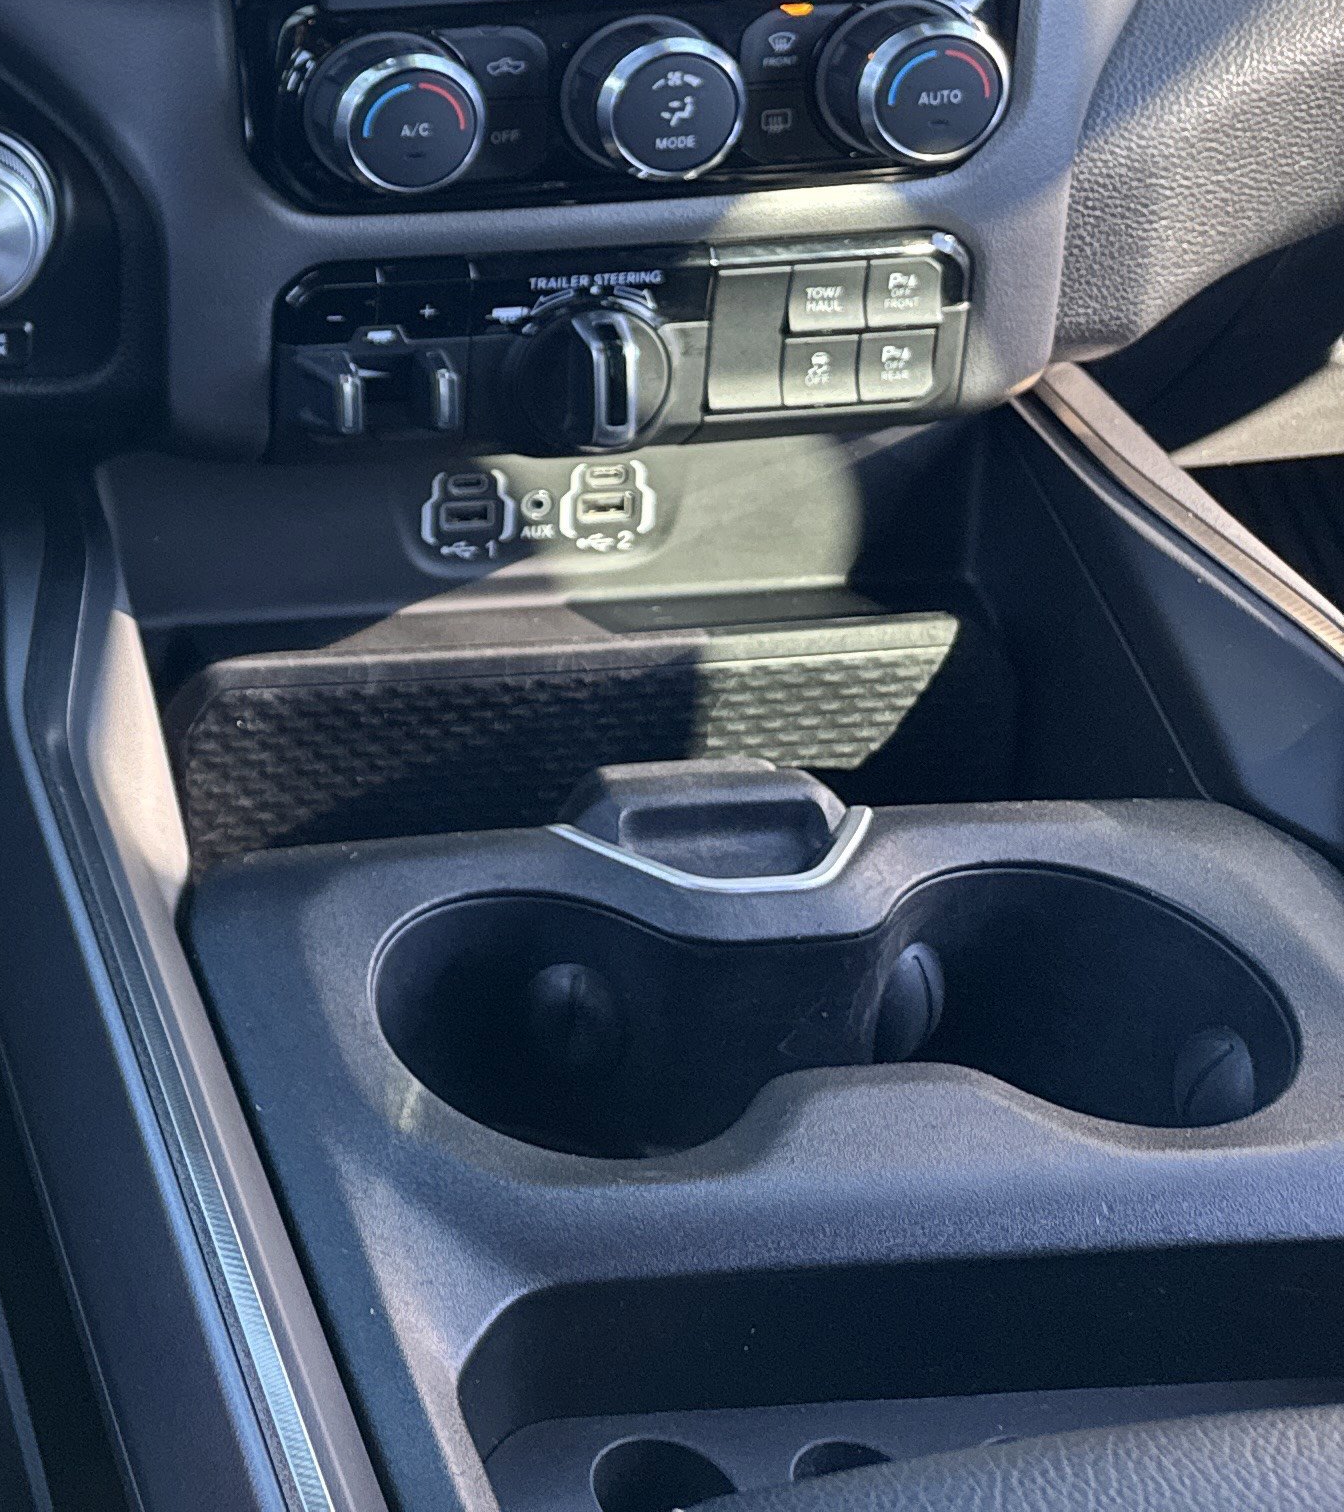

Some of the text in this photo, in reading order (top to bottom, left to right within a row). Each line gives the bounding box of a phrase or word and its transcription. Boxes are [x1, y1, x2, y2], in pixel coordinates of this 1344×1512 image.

[918, 89, 963, 106] AUTO
[400, 122, 433, 138] A/C
[490, 129, 520, 145] OFF
[655, 135, 696, 150] MODE
[529, 269, 663, 291] TRAILER STEERING
[805, 286, 844, 299] TOW/
[805, 299, 844, 313] HAUL
[520, 523, 556, 538] AUX
[616, 530, 635, 550] 2
[484, 539, 498, 559] 1
